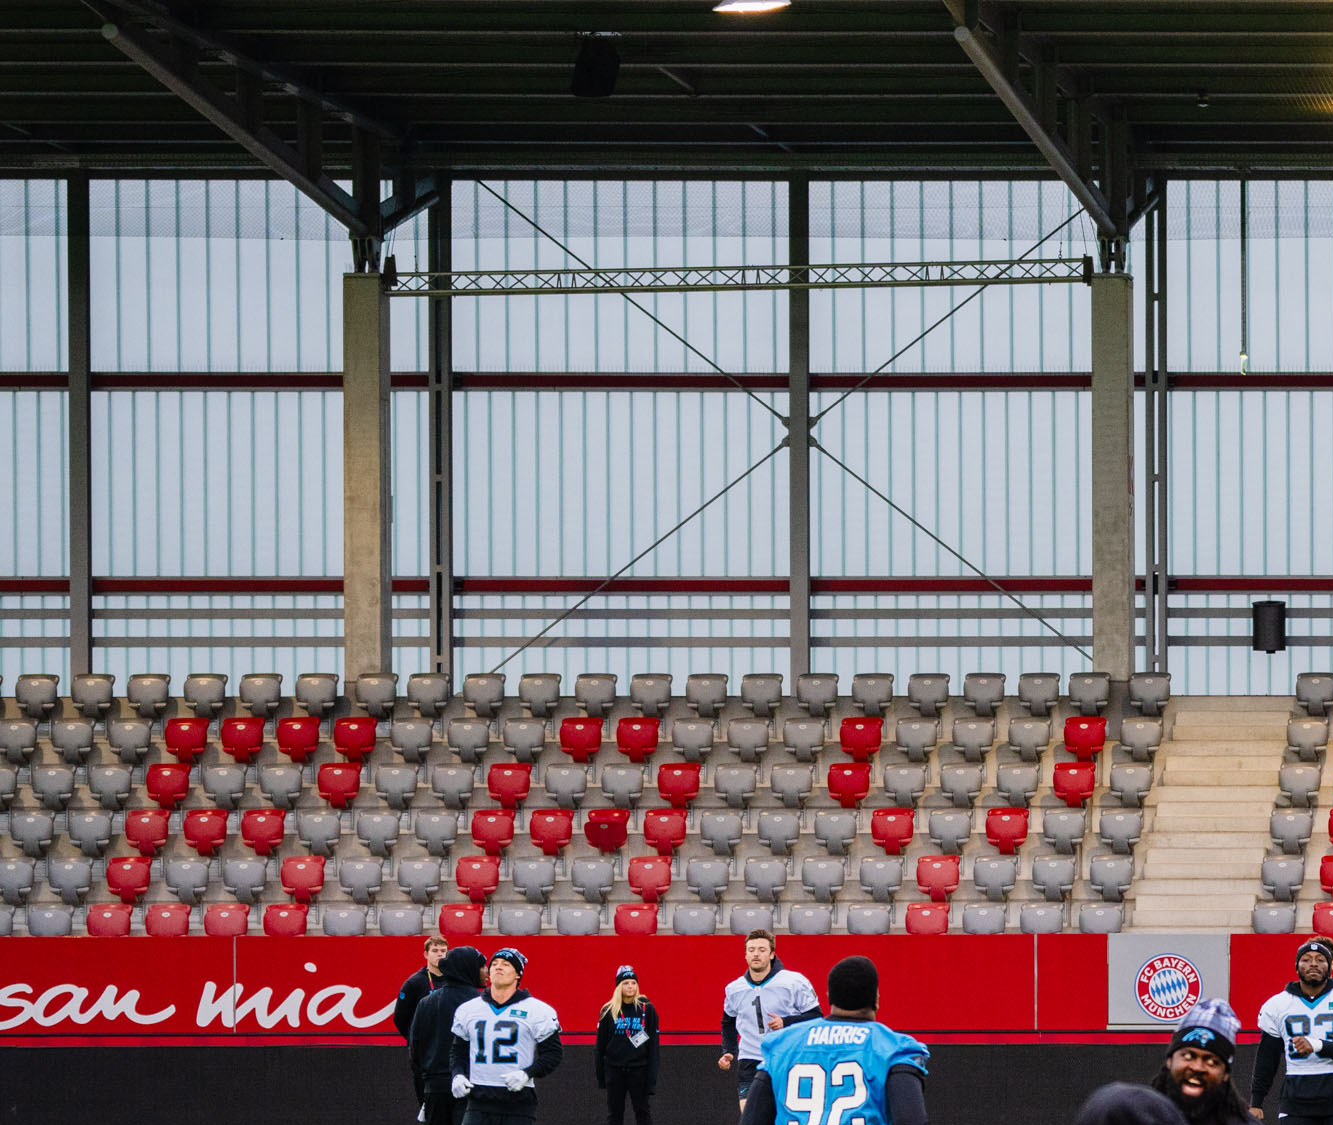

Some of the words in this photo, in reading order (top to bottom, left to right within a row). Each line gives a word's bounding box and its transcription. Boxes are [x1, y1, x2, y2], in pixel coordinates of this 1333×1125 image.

[1140, 967, 1154, 983] FC
[1153, 957, 1197, 983] BAYERN
[196, 962, 397, 1029] mia
[751, 995, 765, 1034] 1
[474, 1020, 519, 1064] 12
[807, 1025, 870, 1046] HARRIS
